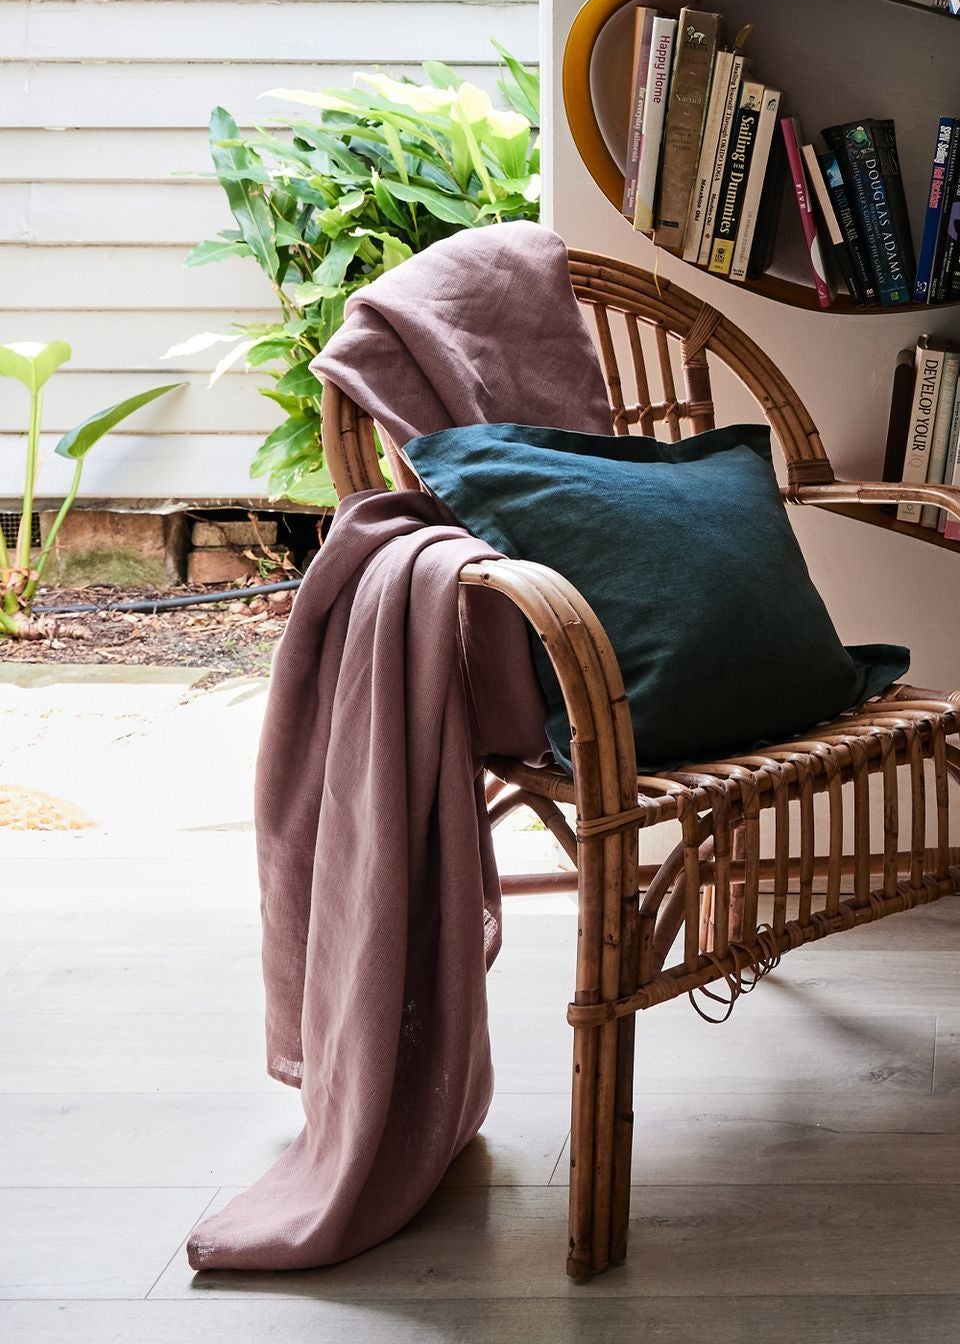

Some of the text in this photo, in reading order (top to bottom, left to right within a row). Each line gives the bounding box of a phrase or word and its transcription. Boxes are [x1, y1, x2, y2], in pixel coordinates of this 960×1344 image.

[652, 34, 670, 103] Happy Home
[713, 63, 740, 181] Healing Yourself Through OKIDO YOGA
[731, 115, 754, 162] Sailing
[719, 171, 743, 234] Dummies
[794, 183, 806, 209] FIVE
[839, 207, 858, 241] THIN AIR
[864, 158, 903, 281] DOUGLAS ADAMS
[911, 358, 938, 452] DEVELOP YOUR
